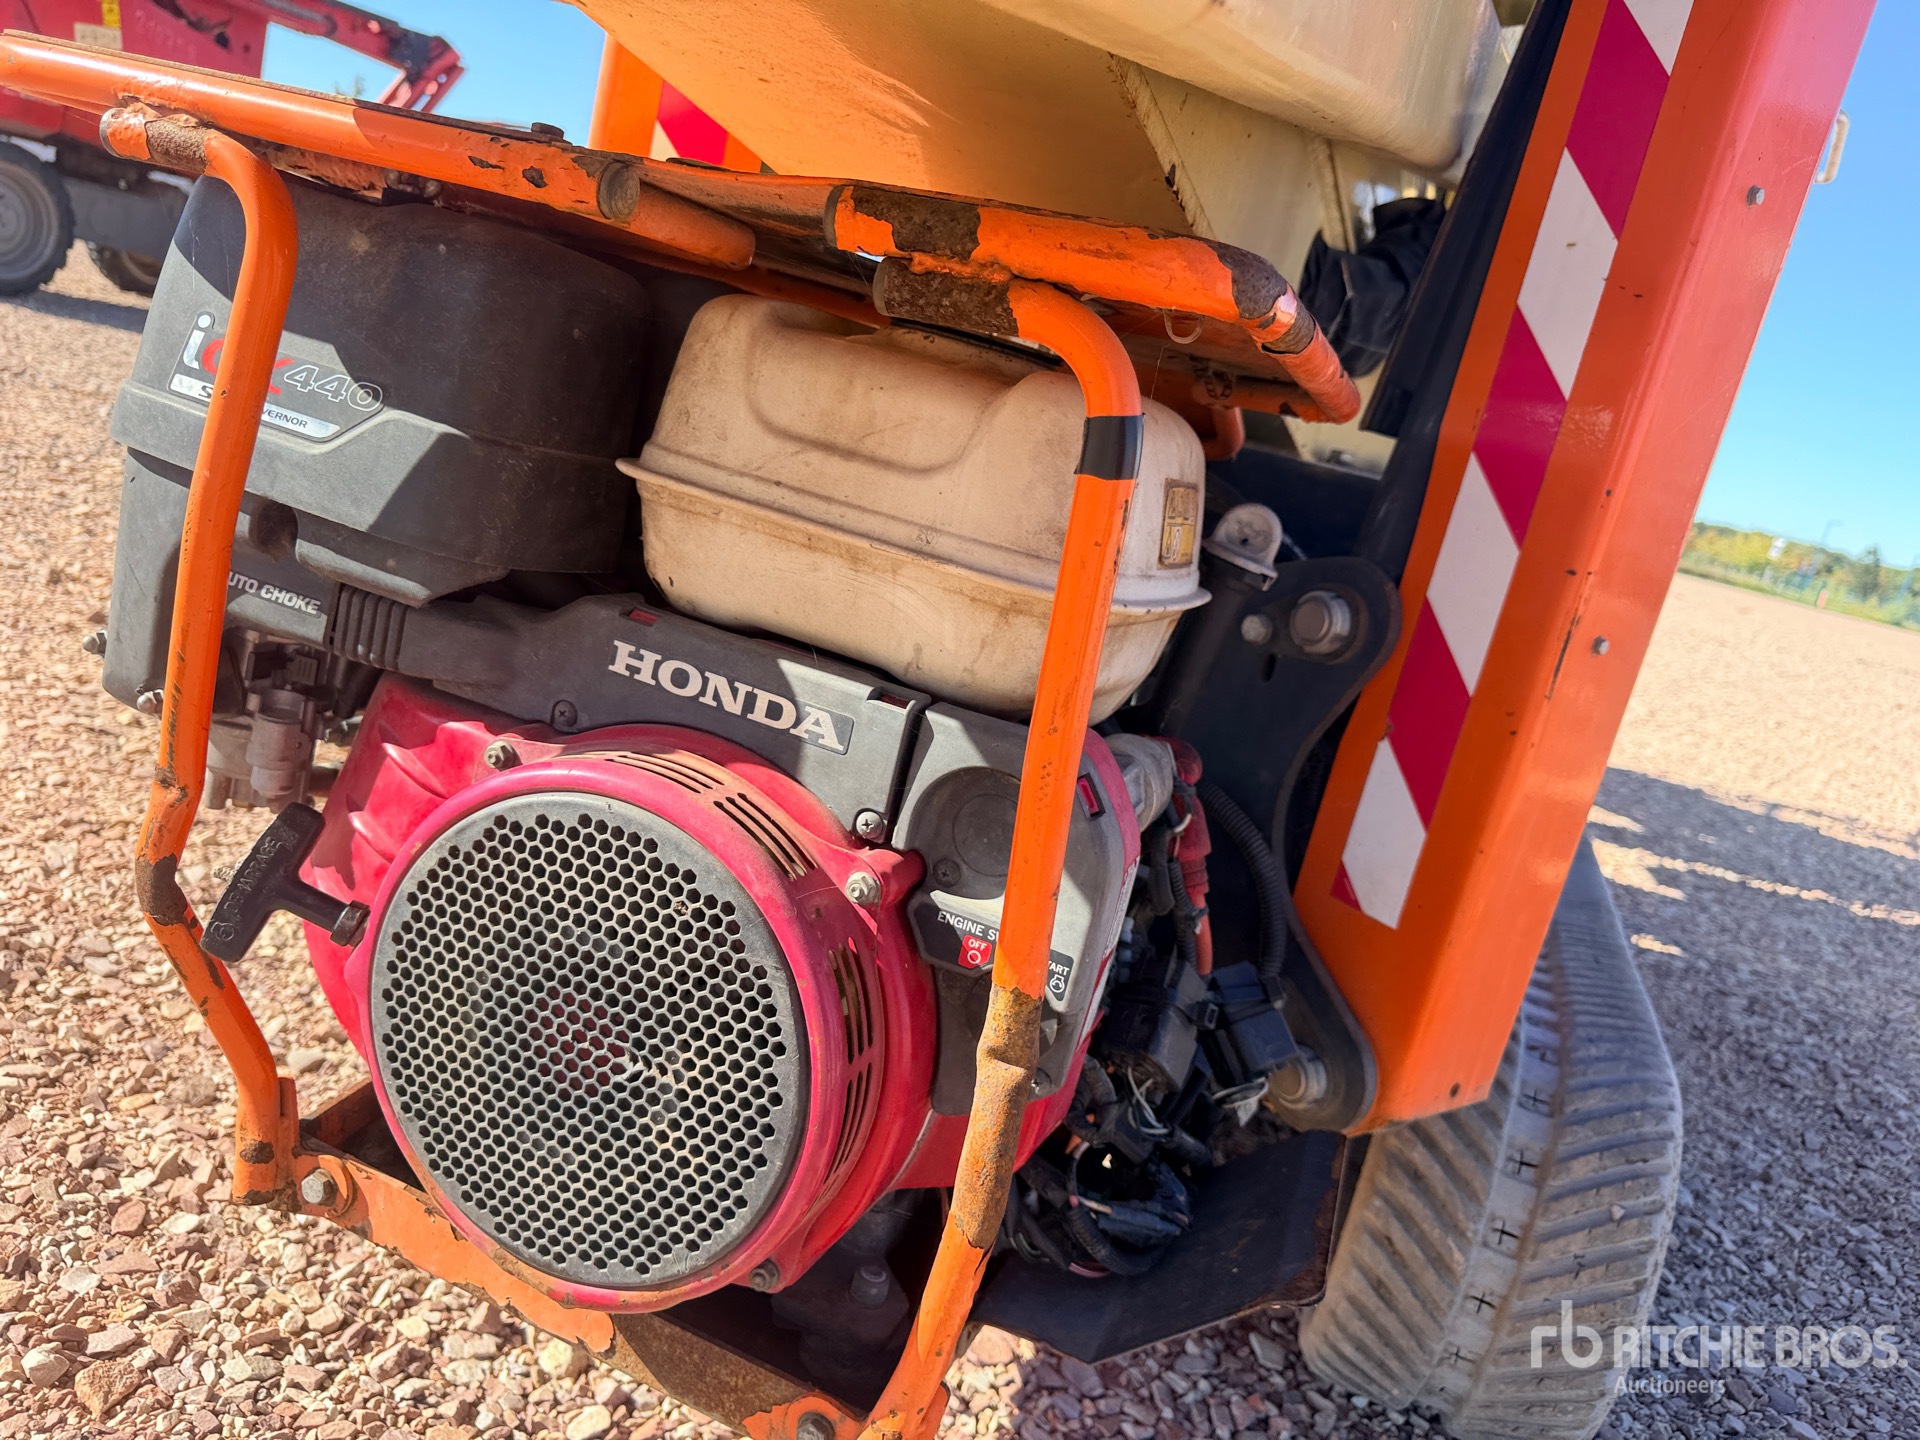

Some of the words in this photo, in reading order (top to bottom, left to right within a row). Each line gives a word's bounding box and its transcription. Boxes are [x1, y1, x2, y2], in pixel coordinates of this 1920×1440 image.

[262, 408, 308, 428] ERNOR
[228, 571, 258, 593] UTO
[260, 584, 321, 614] CHOKE
[608, 640, 846, 751] HONDA
[937, 910, 985, 936] ENGINE
[969, 938, 987, 951] OFF
[1048, 961, 1070, 976] ART
